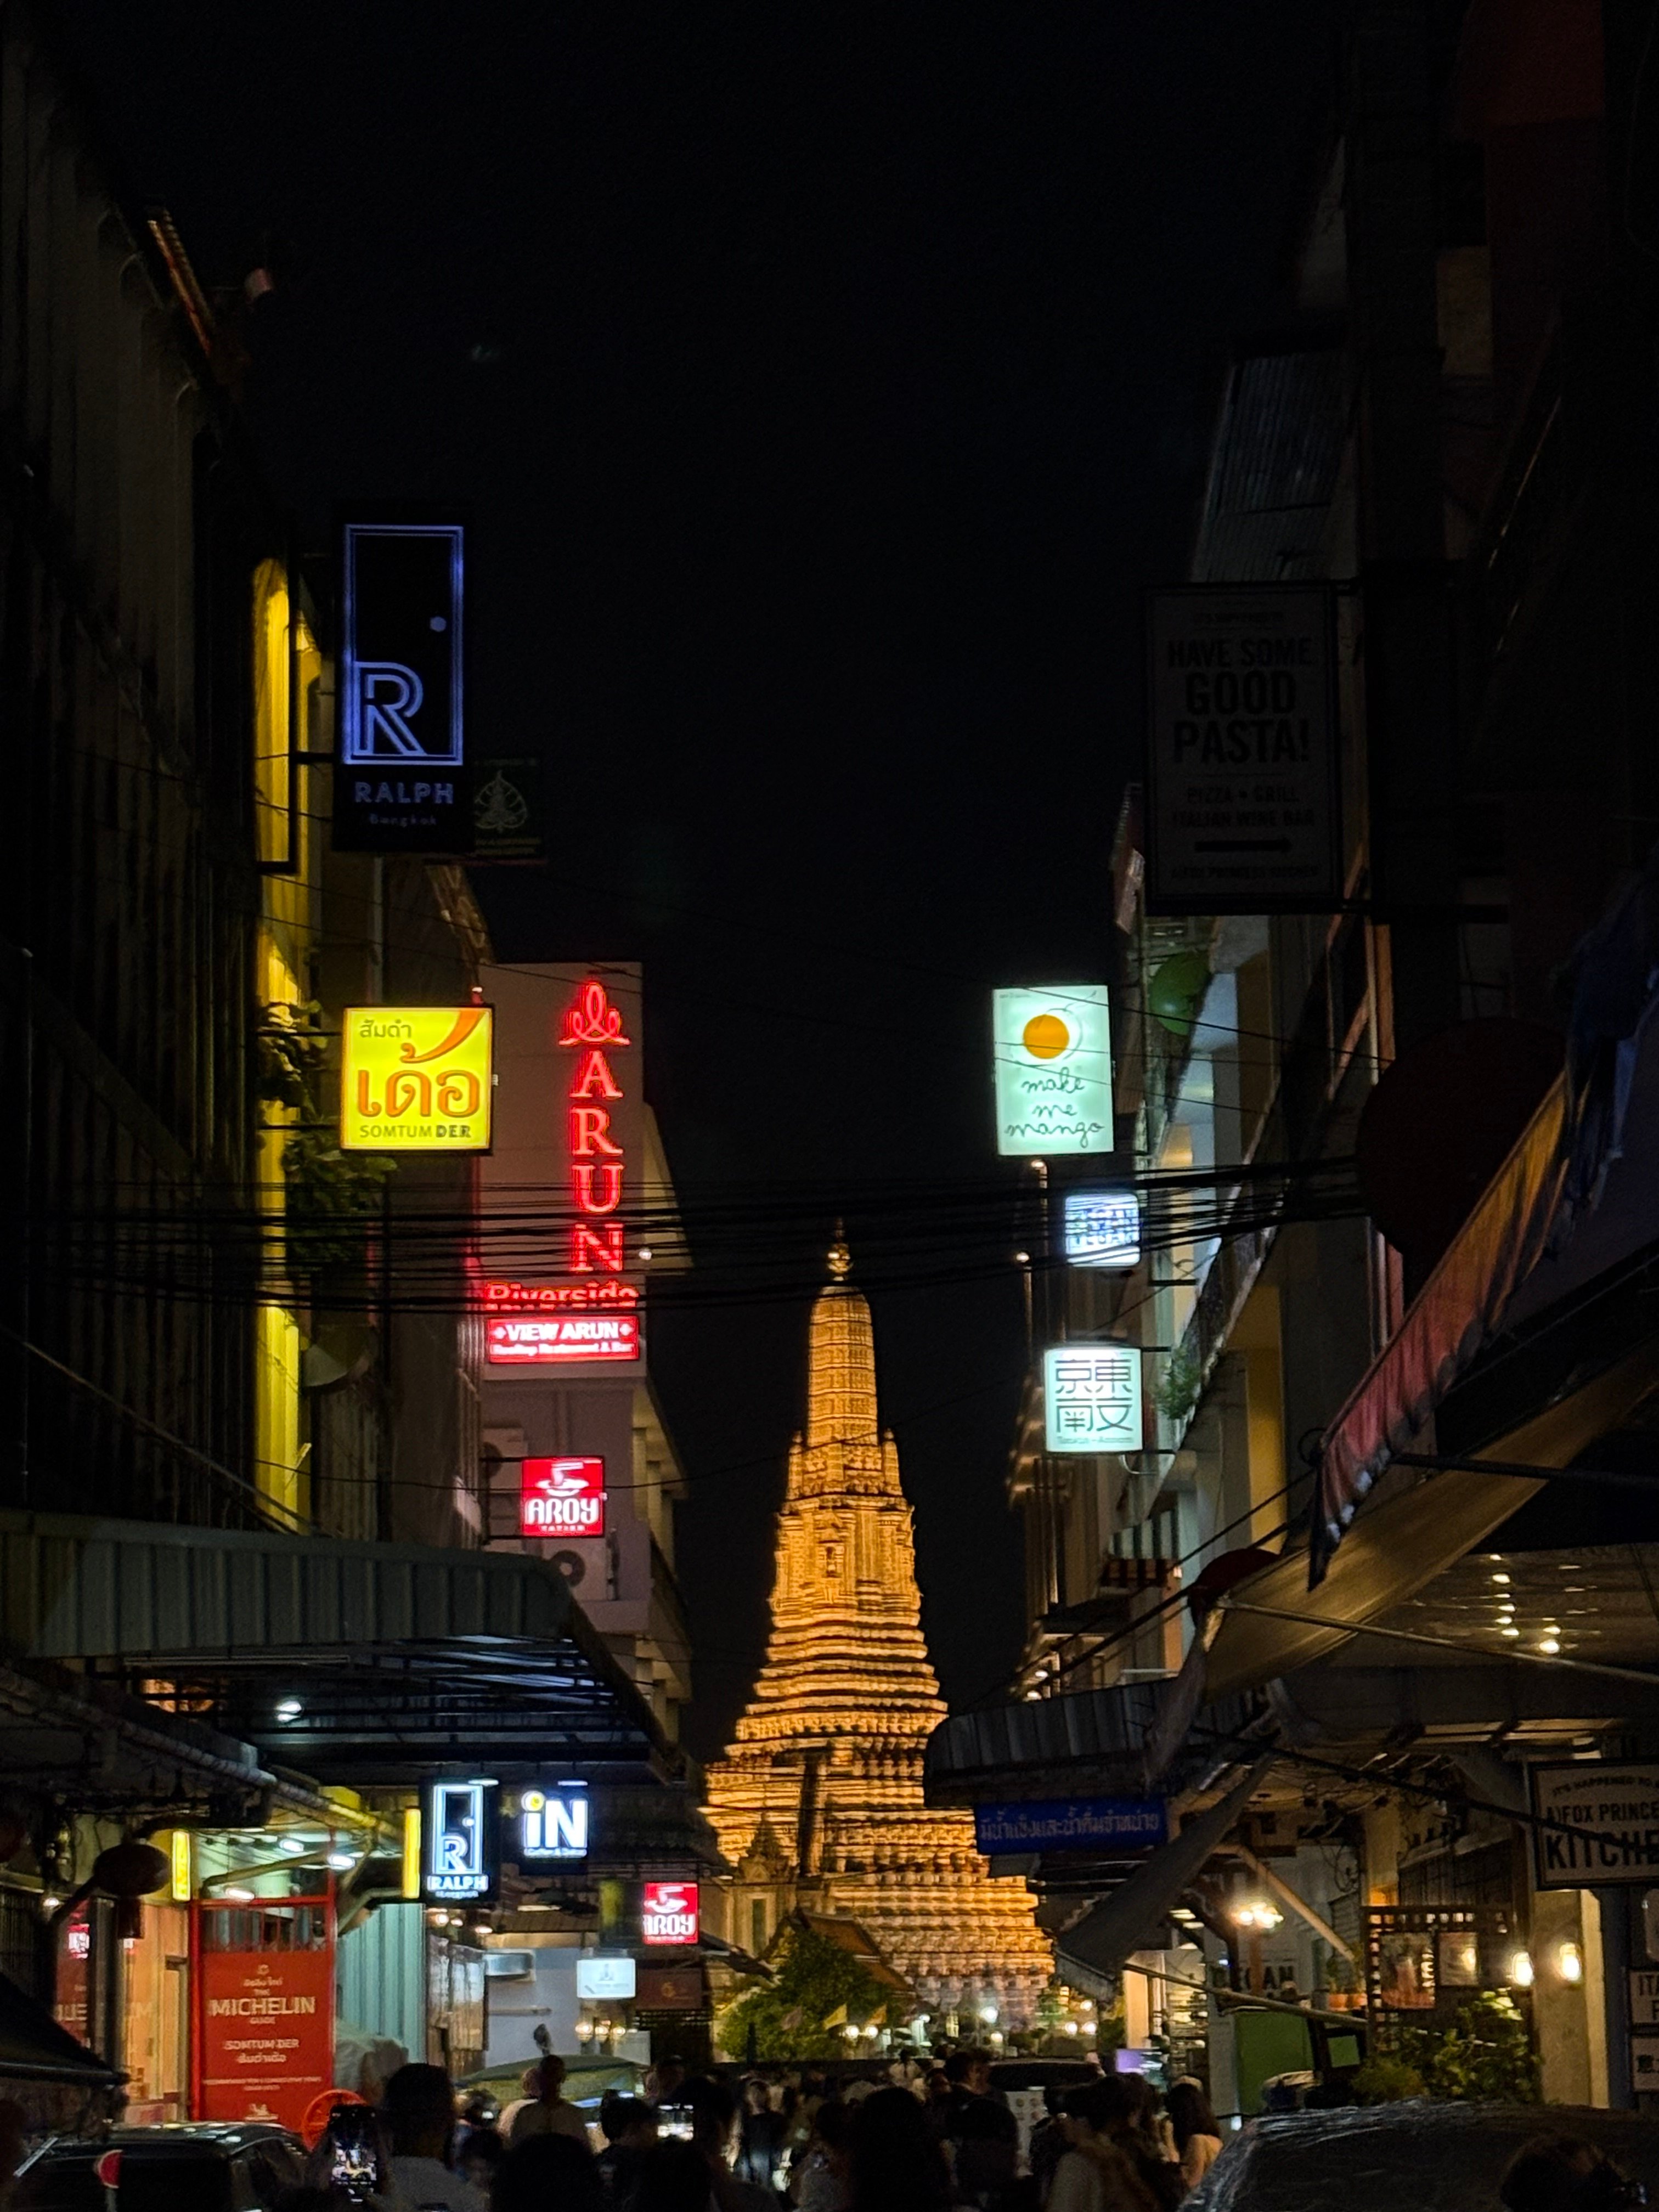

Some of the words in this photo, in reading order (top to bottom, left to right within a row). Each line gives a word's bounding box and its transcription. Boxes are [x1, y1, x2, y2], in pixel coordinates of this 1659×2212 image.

[1168, 639, 1232, 667] HAVE
[1241, 637, 1313, 667] SOME
[1186, 671, 1296, 715] GOOD
[1173, 719, 1310, 763] PASTA!
[355, 781, 454, 804] RALPH
[359, 1018, 411, 1039] ส้มตำ
[1020, 1066, 1086, 1094] make
[1031, 1103, 1077, 1118] me
[359, 1125, 432, 1138] SOMTUM
[435, 1124, 472, 1138] DER
[1004, 1122, 1105, 1149] mango
[568, 1049, 624, 1272] ARUN
[505, 1323, 560, 1341] VIEW
[560, 1321, 619, 1340] ARUN
[524, 1498, 599, 1525] AROY
[428, 1875, 488, 1892] RALPH
[208, 1996, 315, 2016] MICHELIN
[223, 2039, 275, 2050] SOMTUM
[276, 2039, 300, 2048] DER
